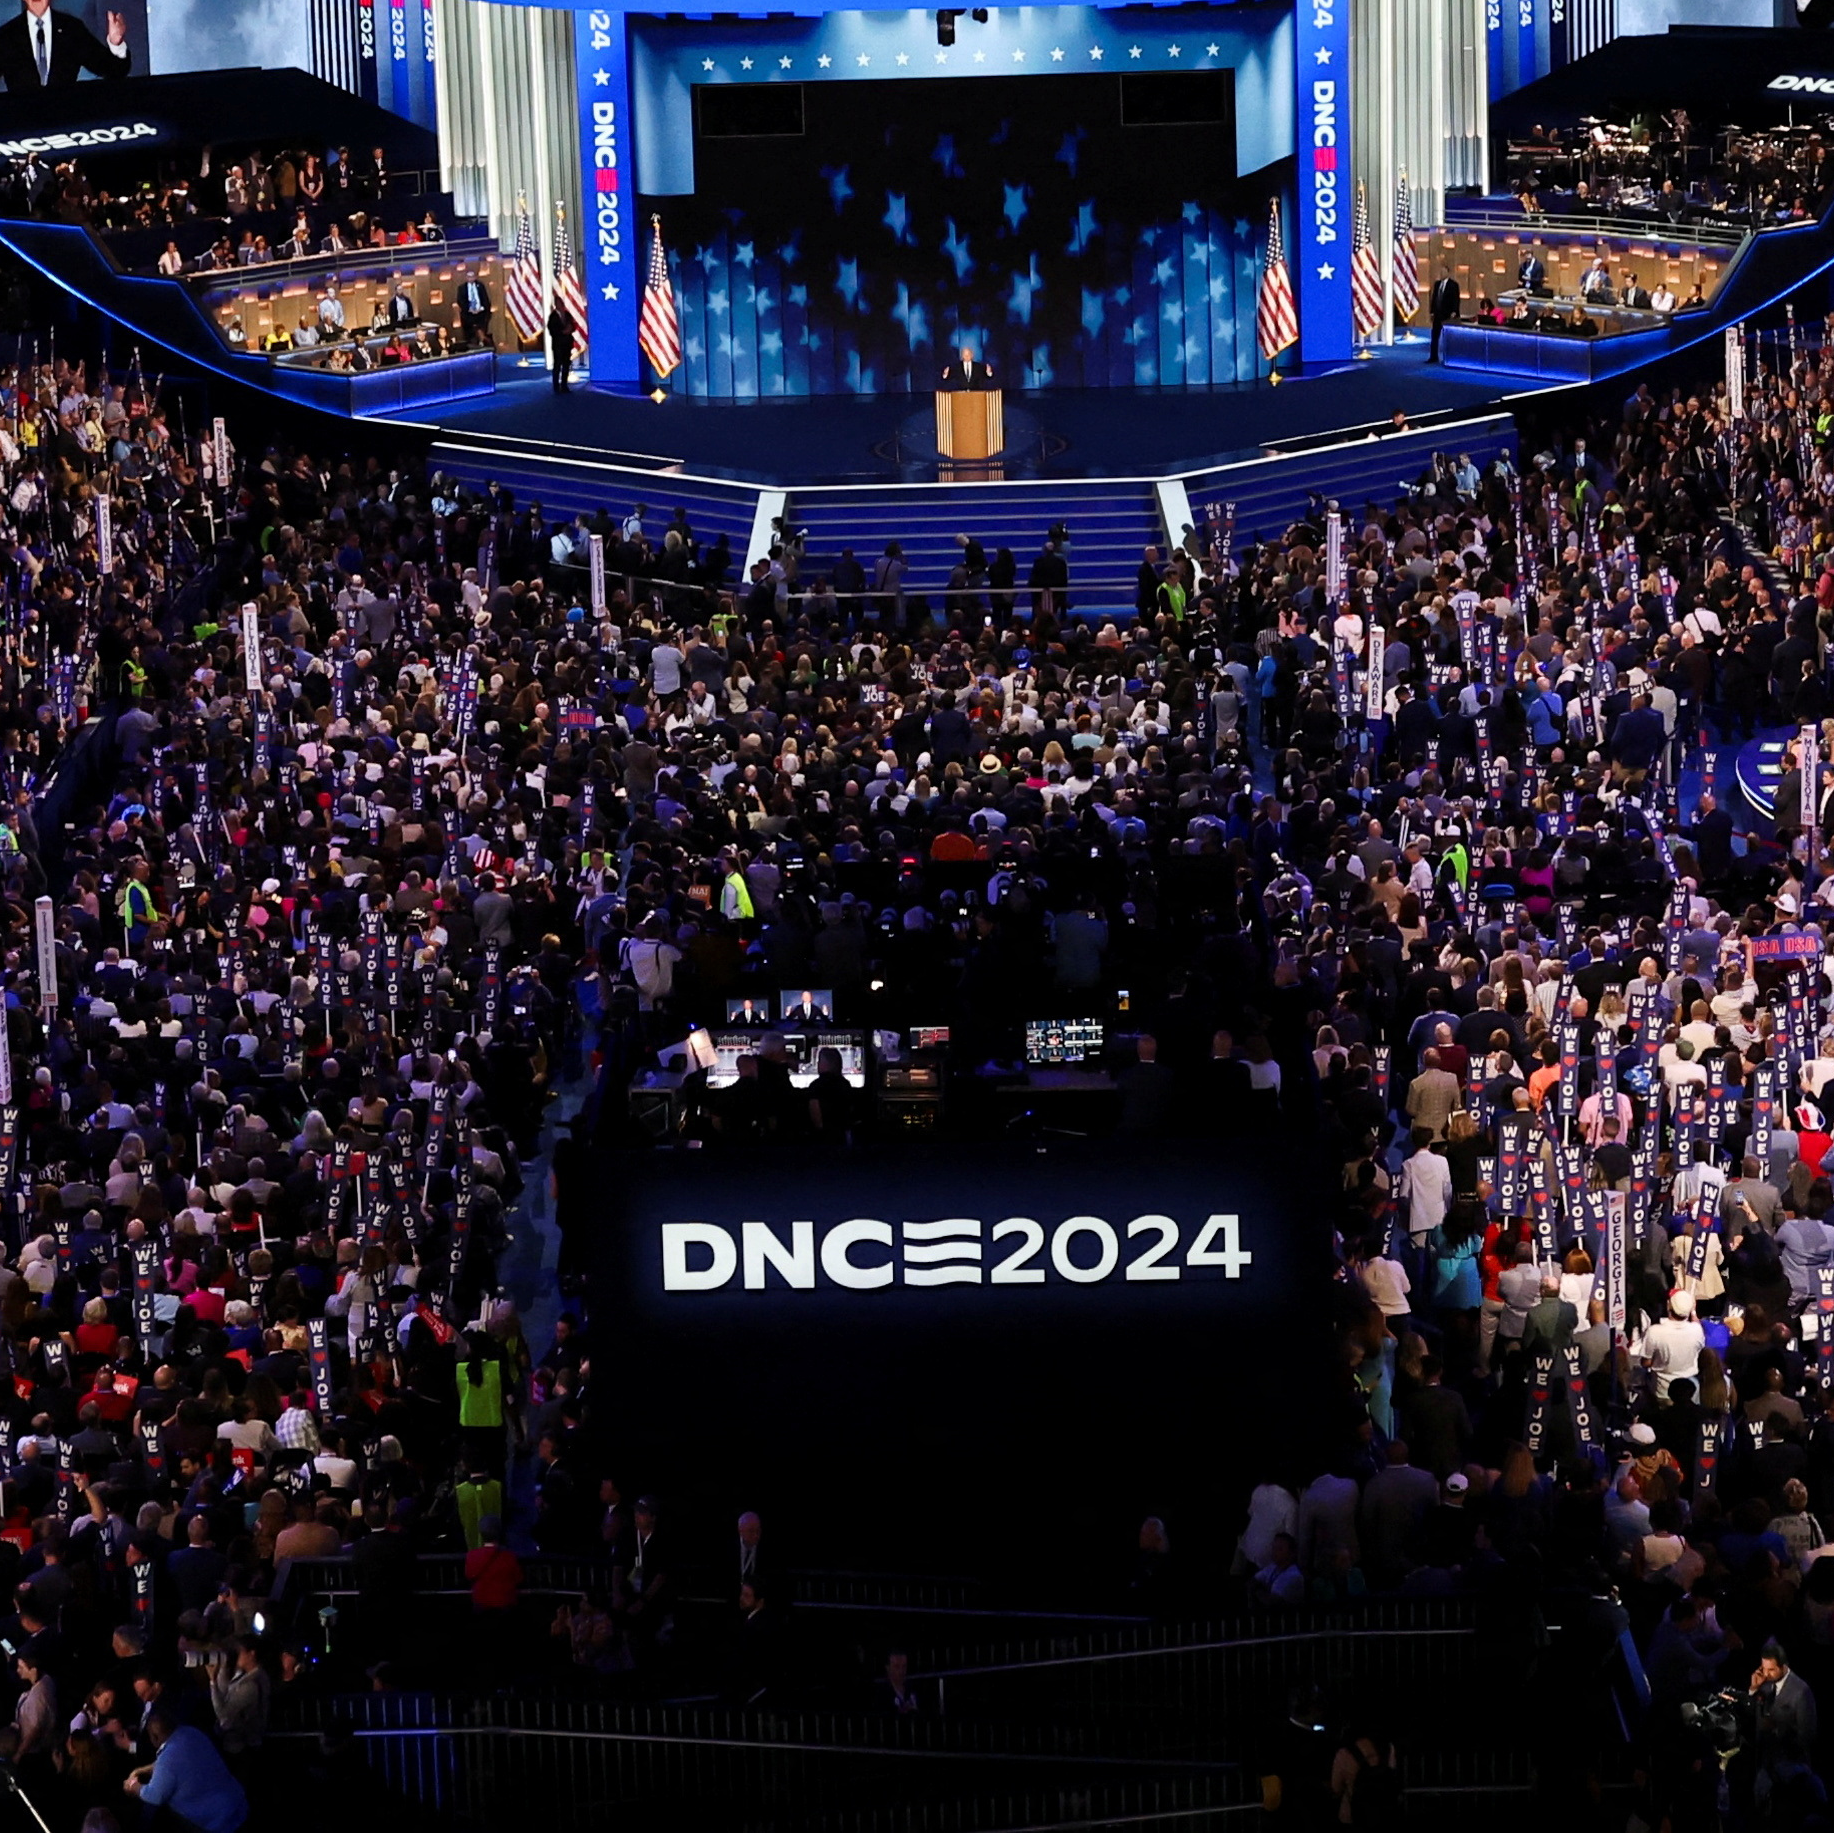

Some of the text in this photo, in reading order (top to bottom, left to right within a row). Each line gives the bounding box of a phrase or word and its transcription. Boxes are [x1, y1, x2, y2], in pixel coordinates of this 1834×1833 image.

[246, 614, 259, 677] ILLINOIS
[1371, 640, 1381, 706] DELAWARE
[861, 684, 877, 694] WE
[863, 692, 885, 703] JOE
[1804, 738, 1812, 811] MINNESOTA
[1784, 936, 1816, 954] USA
[1562, 1024, 1578, 1109] WE JOE
[4, 1109, 17, 1133] WE
[1502, 1126, 1517, 1209] WE JOE
[1611, 1210, 1622, 1306] GEORGIA
[310, 1321, 329, 1409] WE JOE
